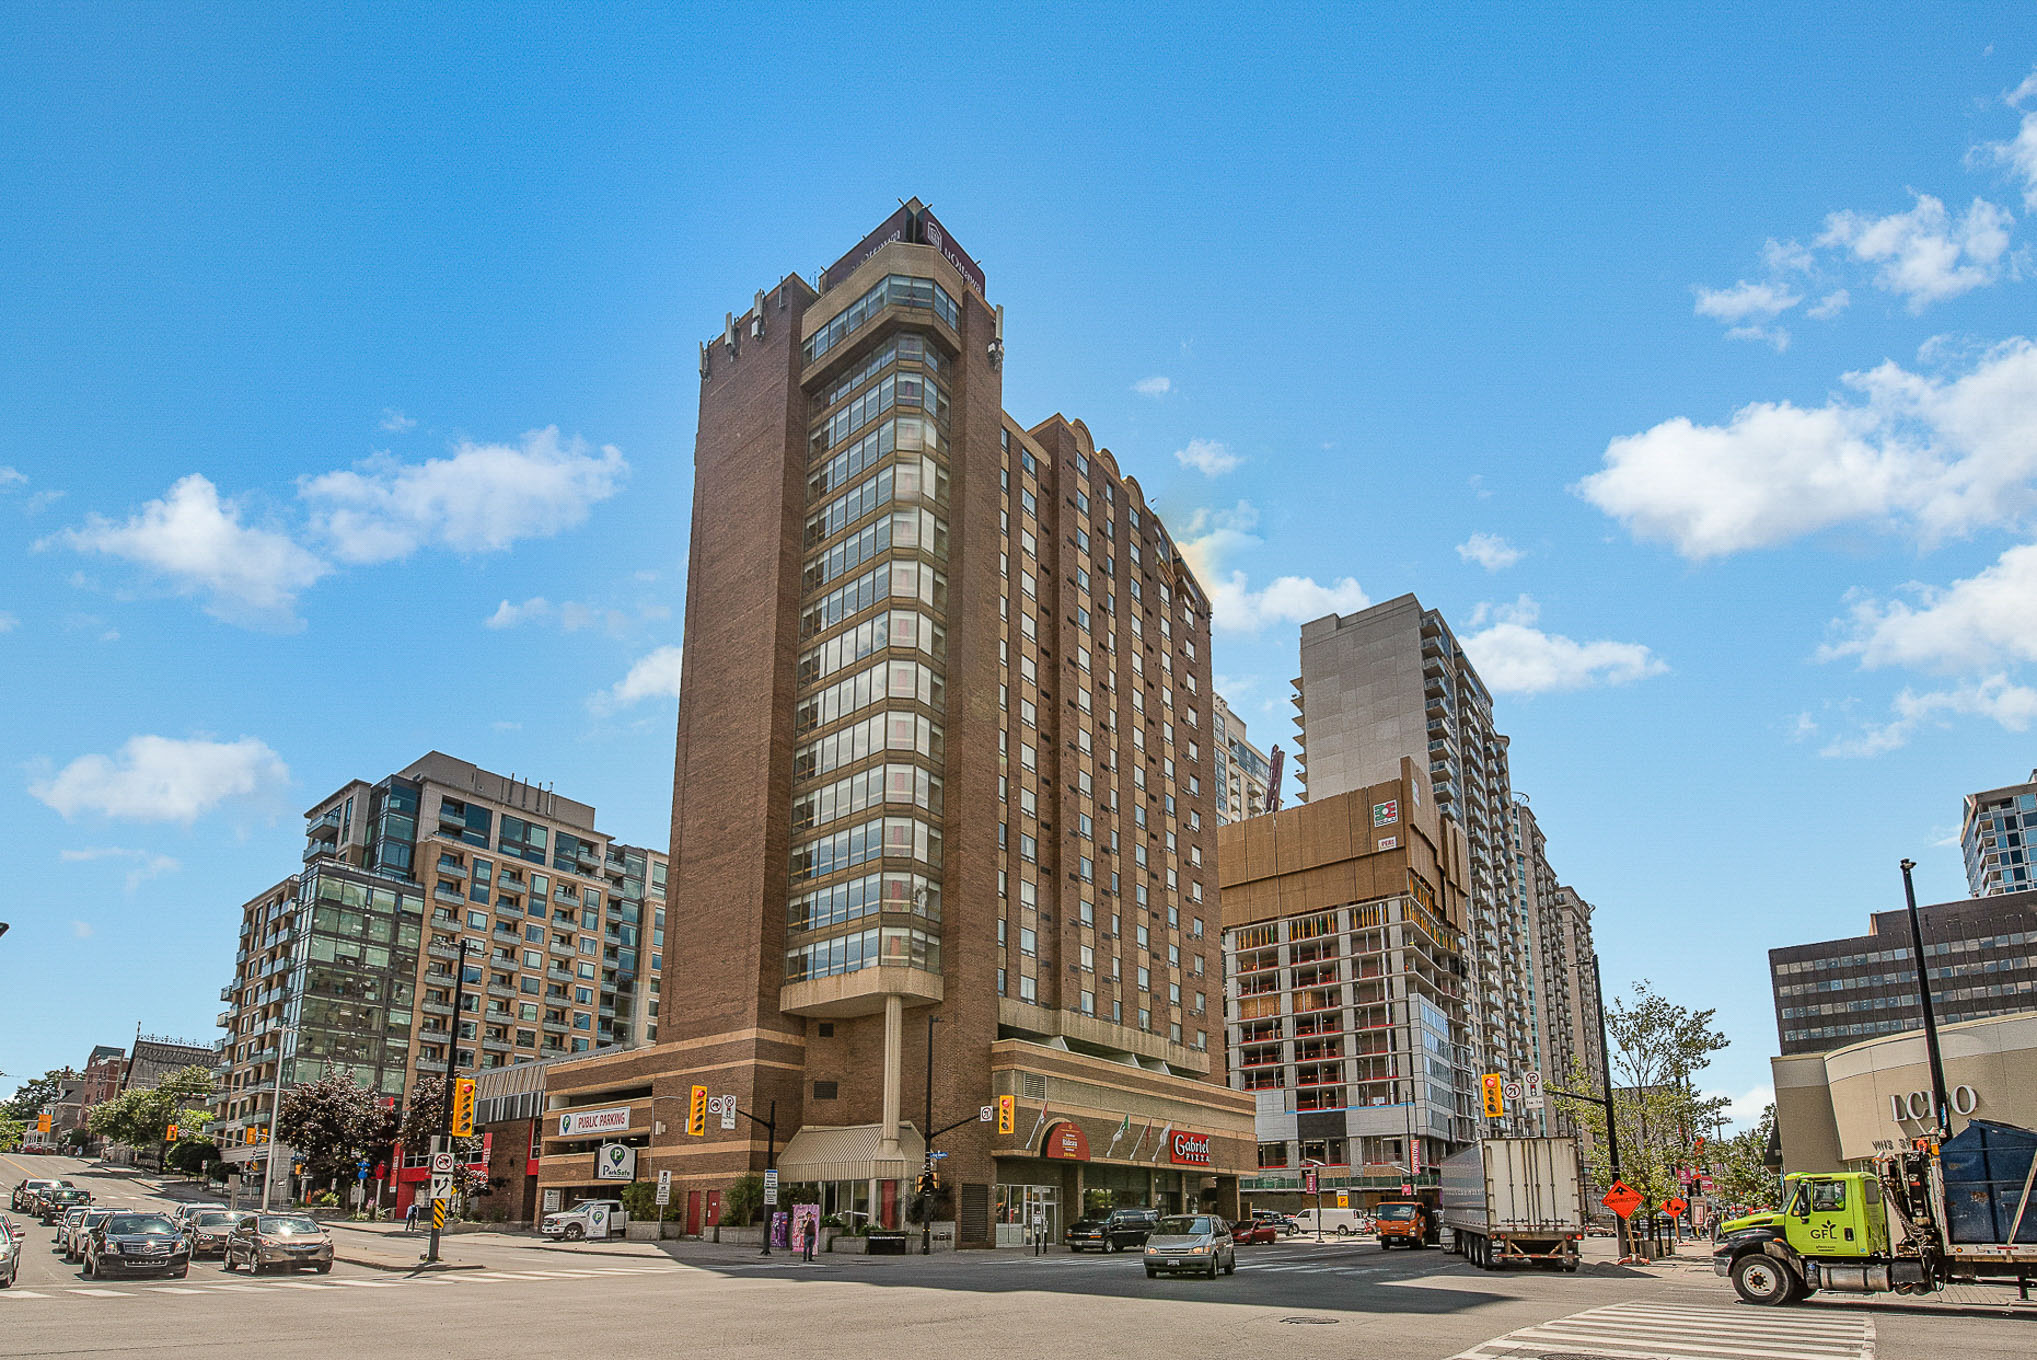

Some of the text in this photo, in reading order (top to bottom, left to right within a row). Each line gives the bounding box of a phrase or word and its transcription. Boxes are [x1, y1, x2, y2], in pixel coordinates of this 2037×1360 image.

[578, 1112, 626, 1128] PUBLIC PARKING
[1175, 1134, 1209, 1155] Gabriel
[1186, 1153, 1210, 1162] PIZZA
[602, 1164, 630, 1176] ParkSafe
[1603, 1196, 1640, 1204] CONSTRUCTION
[1810, 1225, 1837, 1239] GFL
